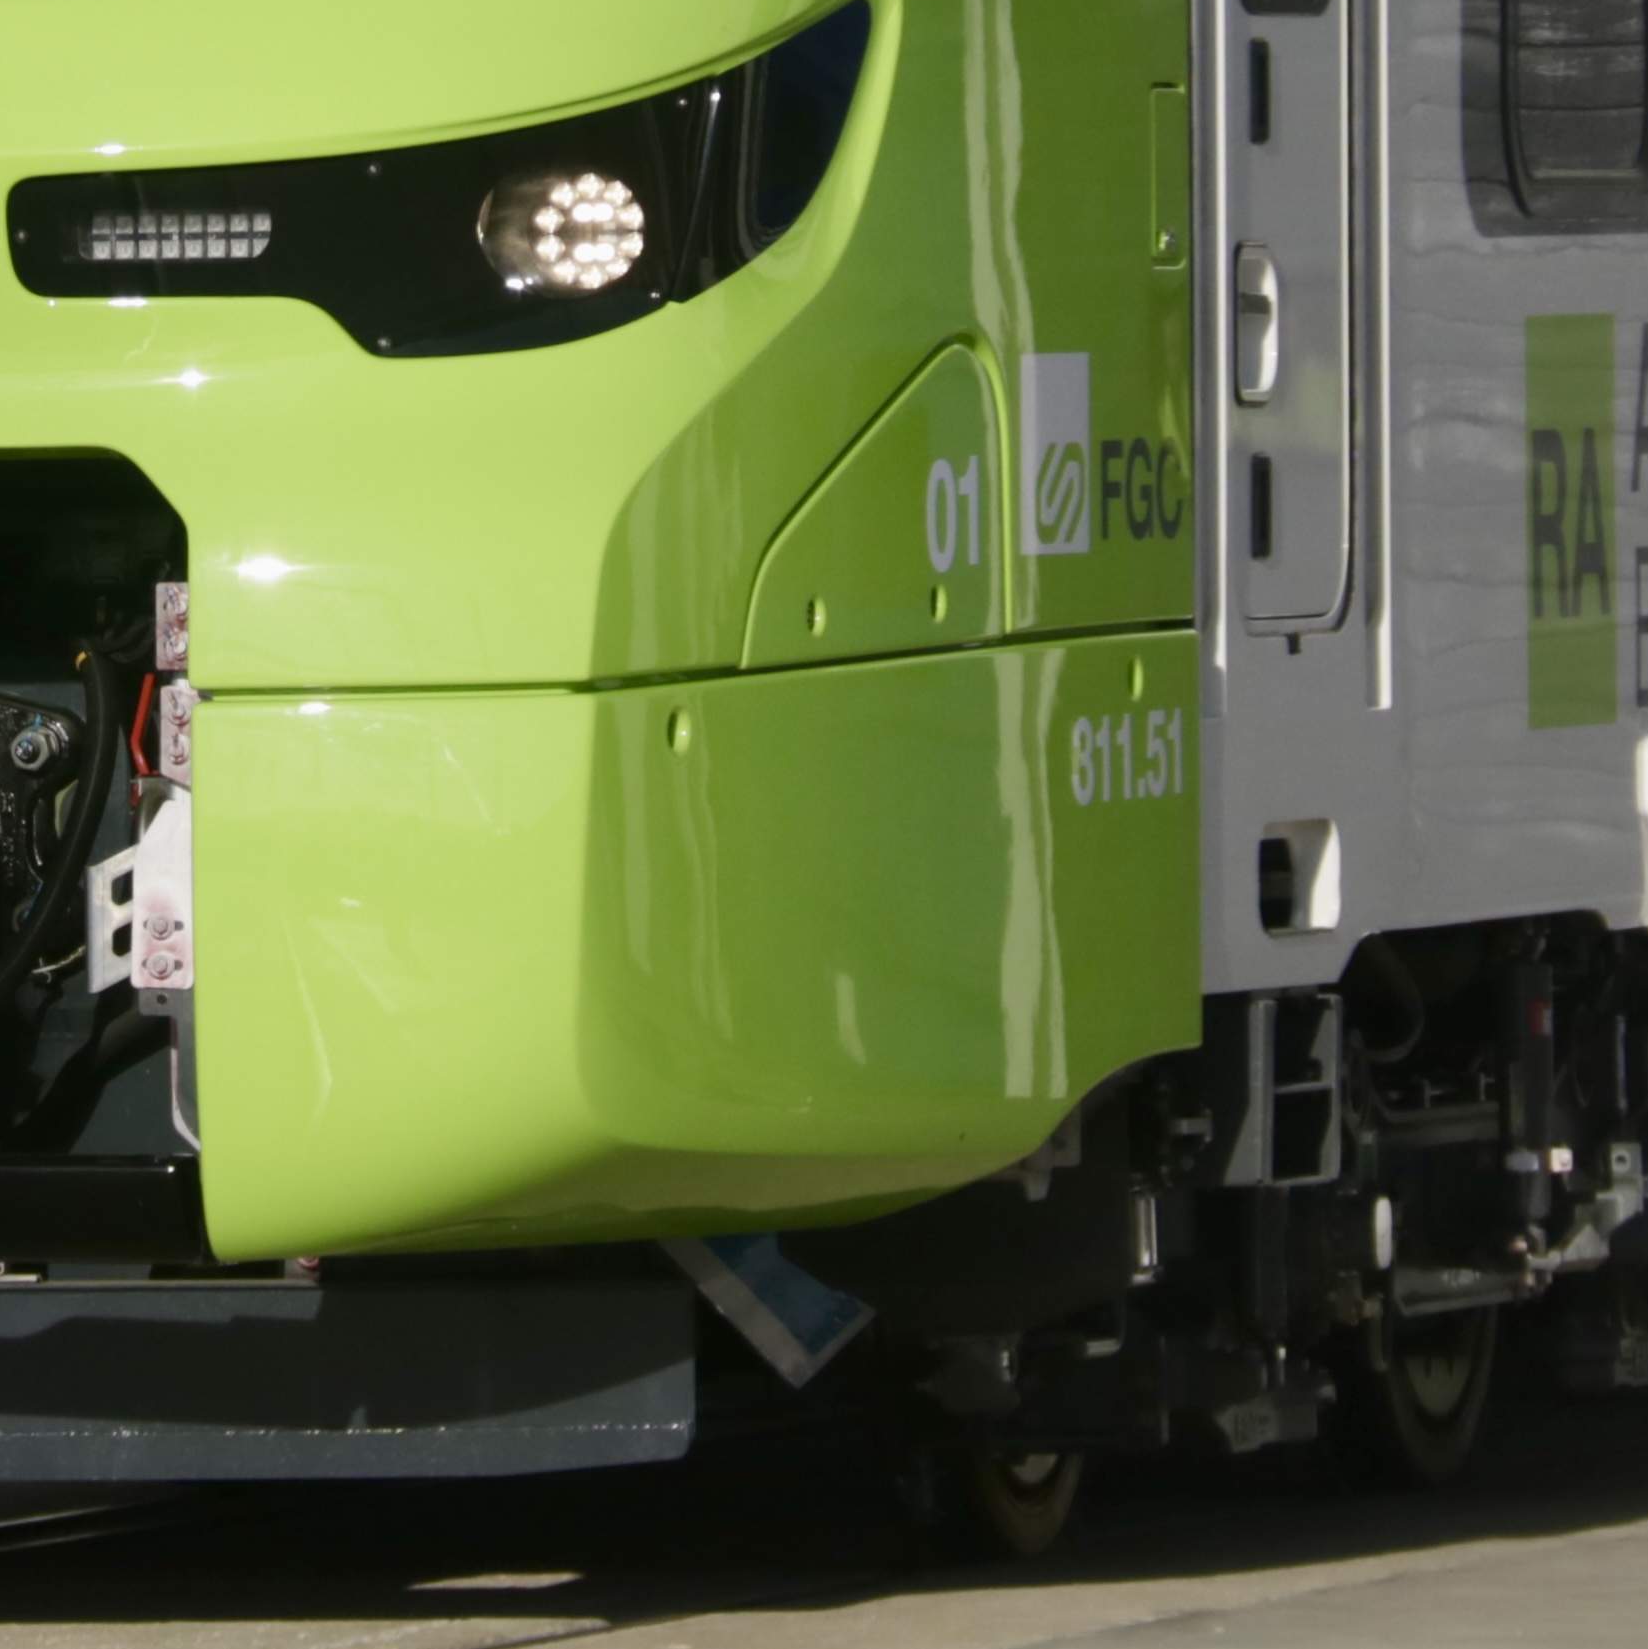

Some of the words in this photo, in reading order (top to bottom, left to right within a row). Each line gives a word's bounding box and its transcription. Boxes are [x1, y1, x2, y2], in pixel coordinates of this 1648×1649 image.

[926, 455, 981, 574] 01
[1100, 437, 1184, 541] FGC
[1531, 427, 1611, 619] RA
[1071, 707, 1183, 806] 811.51
